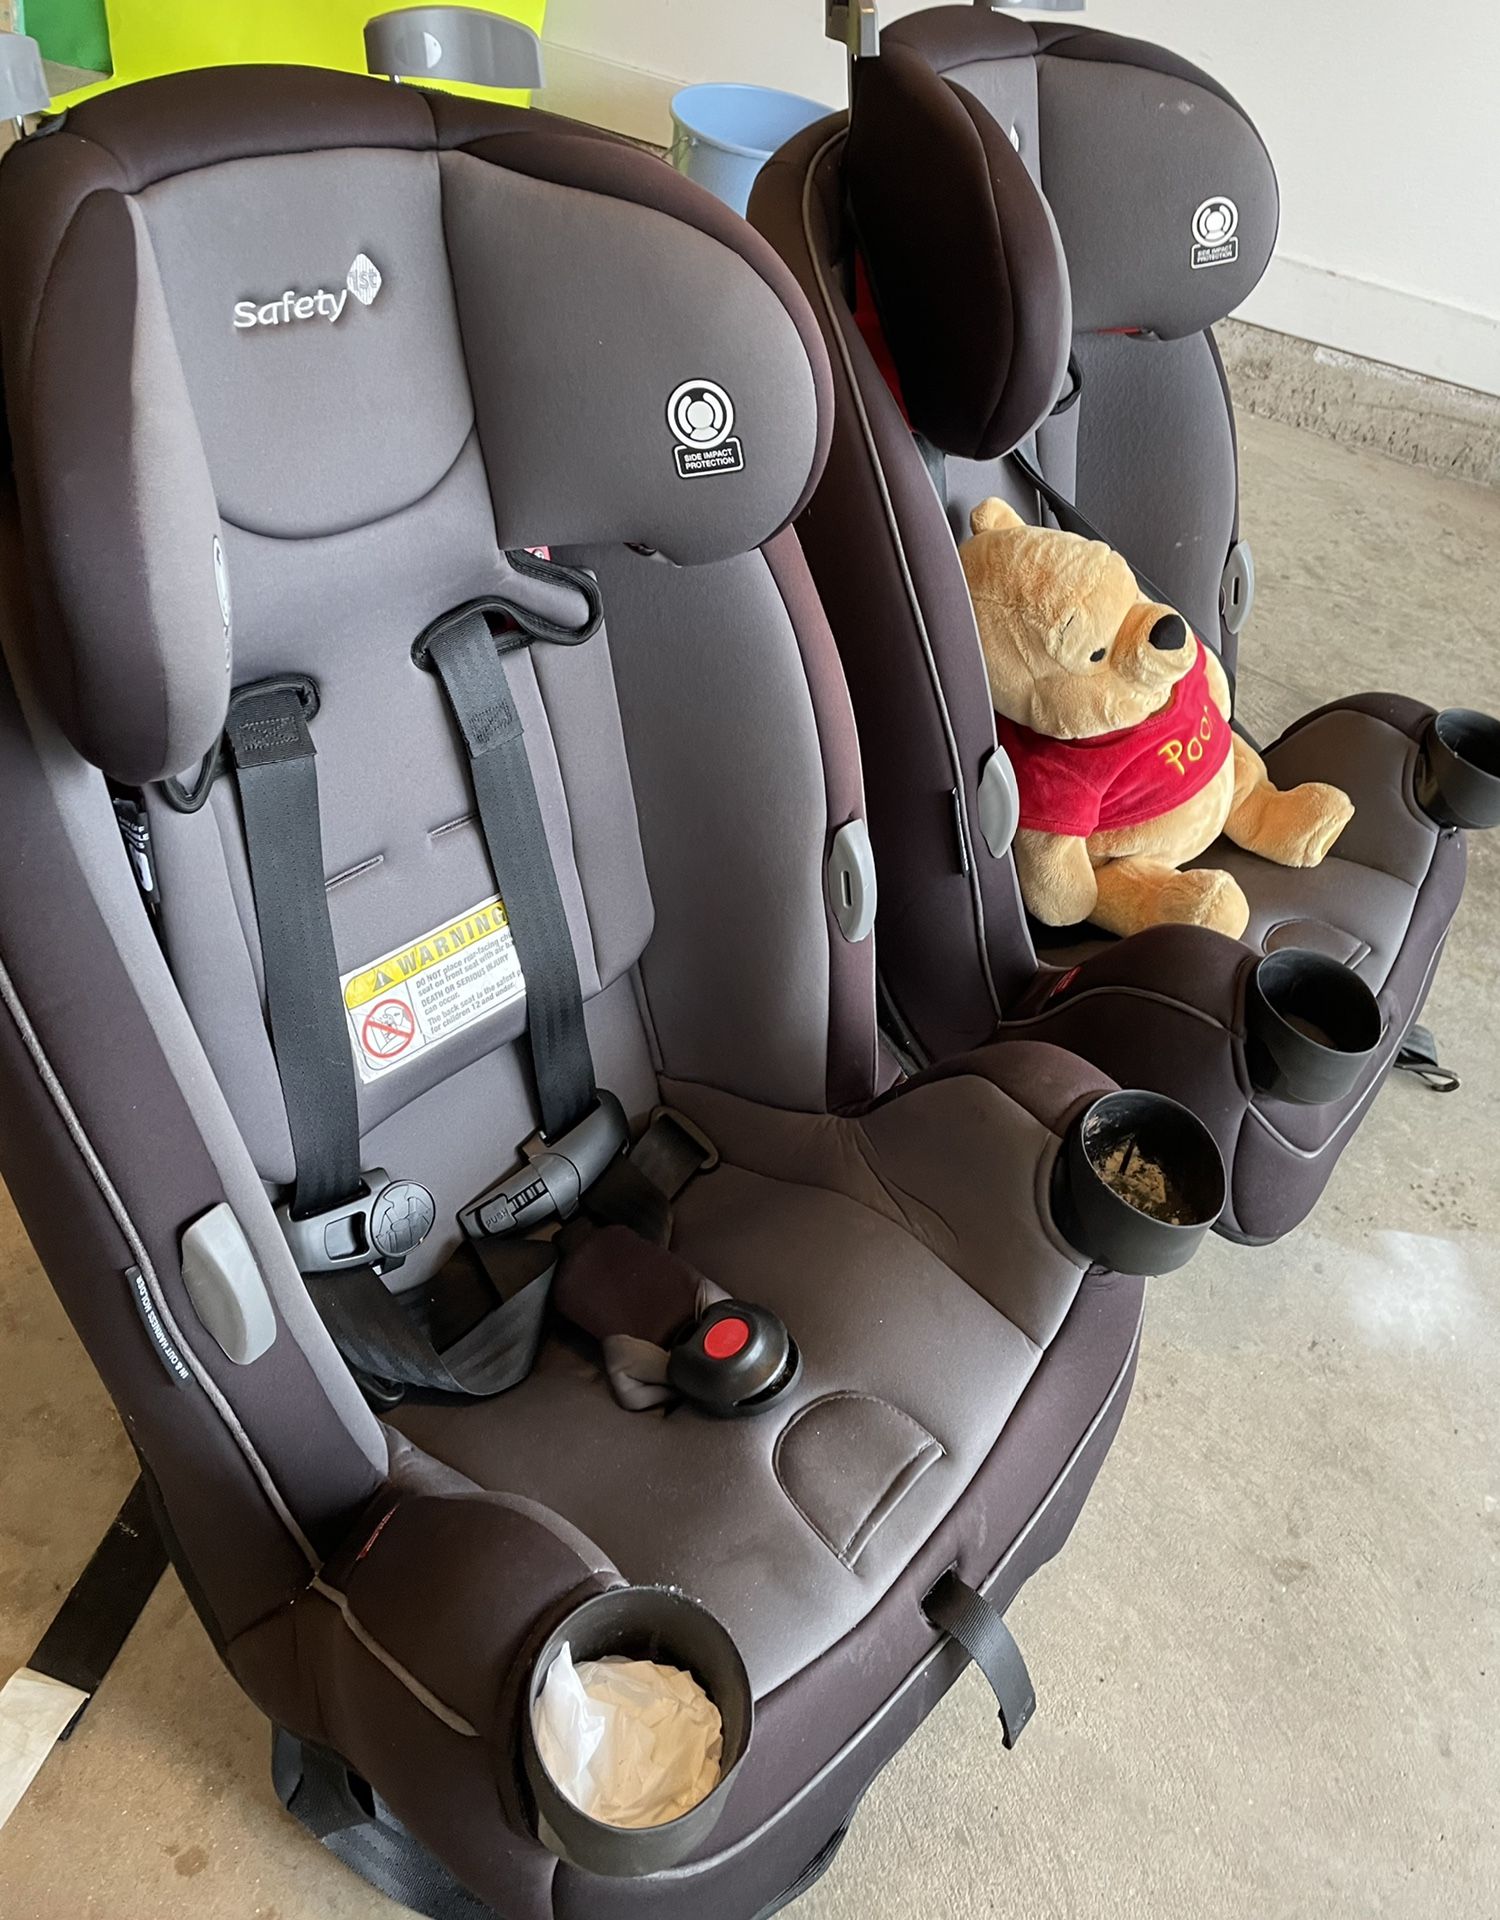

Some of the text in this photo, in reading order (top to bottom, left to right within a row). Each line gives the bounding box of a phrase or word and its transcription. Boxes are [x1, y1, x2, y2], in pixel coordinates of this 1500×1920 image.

[233, 268, 378, 329] Safety 1st
[683, 448, 733, 462] SIDE IMPACT
[685, 456, 735, 470] PROTECTION
[1157, 705, 1212, 776] Poo
[397, 906, 507, 976] WARNING
[416, 977, 426, 989] DO
[426, 969, 441, 982] NOT
[443, 960, 463, 977] place
[418, 983, 434, 997] seat
[435, 979, 445, 988] on
[446, 967, 463, 982] front
[464, 959, 479, 973] seat
[480, 951, 494, 963] with
[495, 945, 504, 955] air
[421, 953, 509, 1007] DEATH OR SERIOUS INJURY
[425, 991, 460, 1016] can occur.
[427, 1015, 441, 1026] The
[441, 1004, 460, 1018] back
[460, 994, 476, 1008] seat
[484, 985, 495, 995] the
[496, 971, 516, 988] safest
[430, 982, 515, 1034] for children 12 and under.
[486, 1207, 509, 1228] PUSH
[136, 1274, 189, 1379] IN & OUT HARNESS HOLDER
